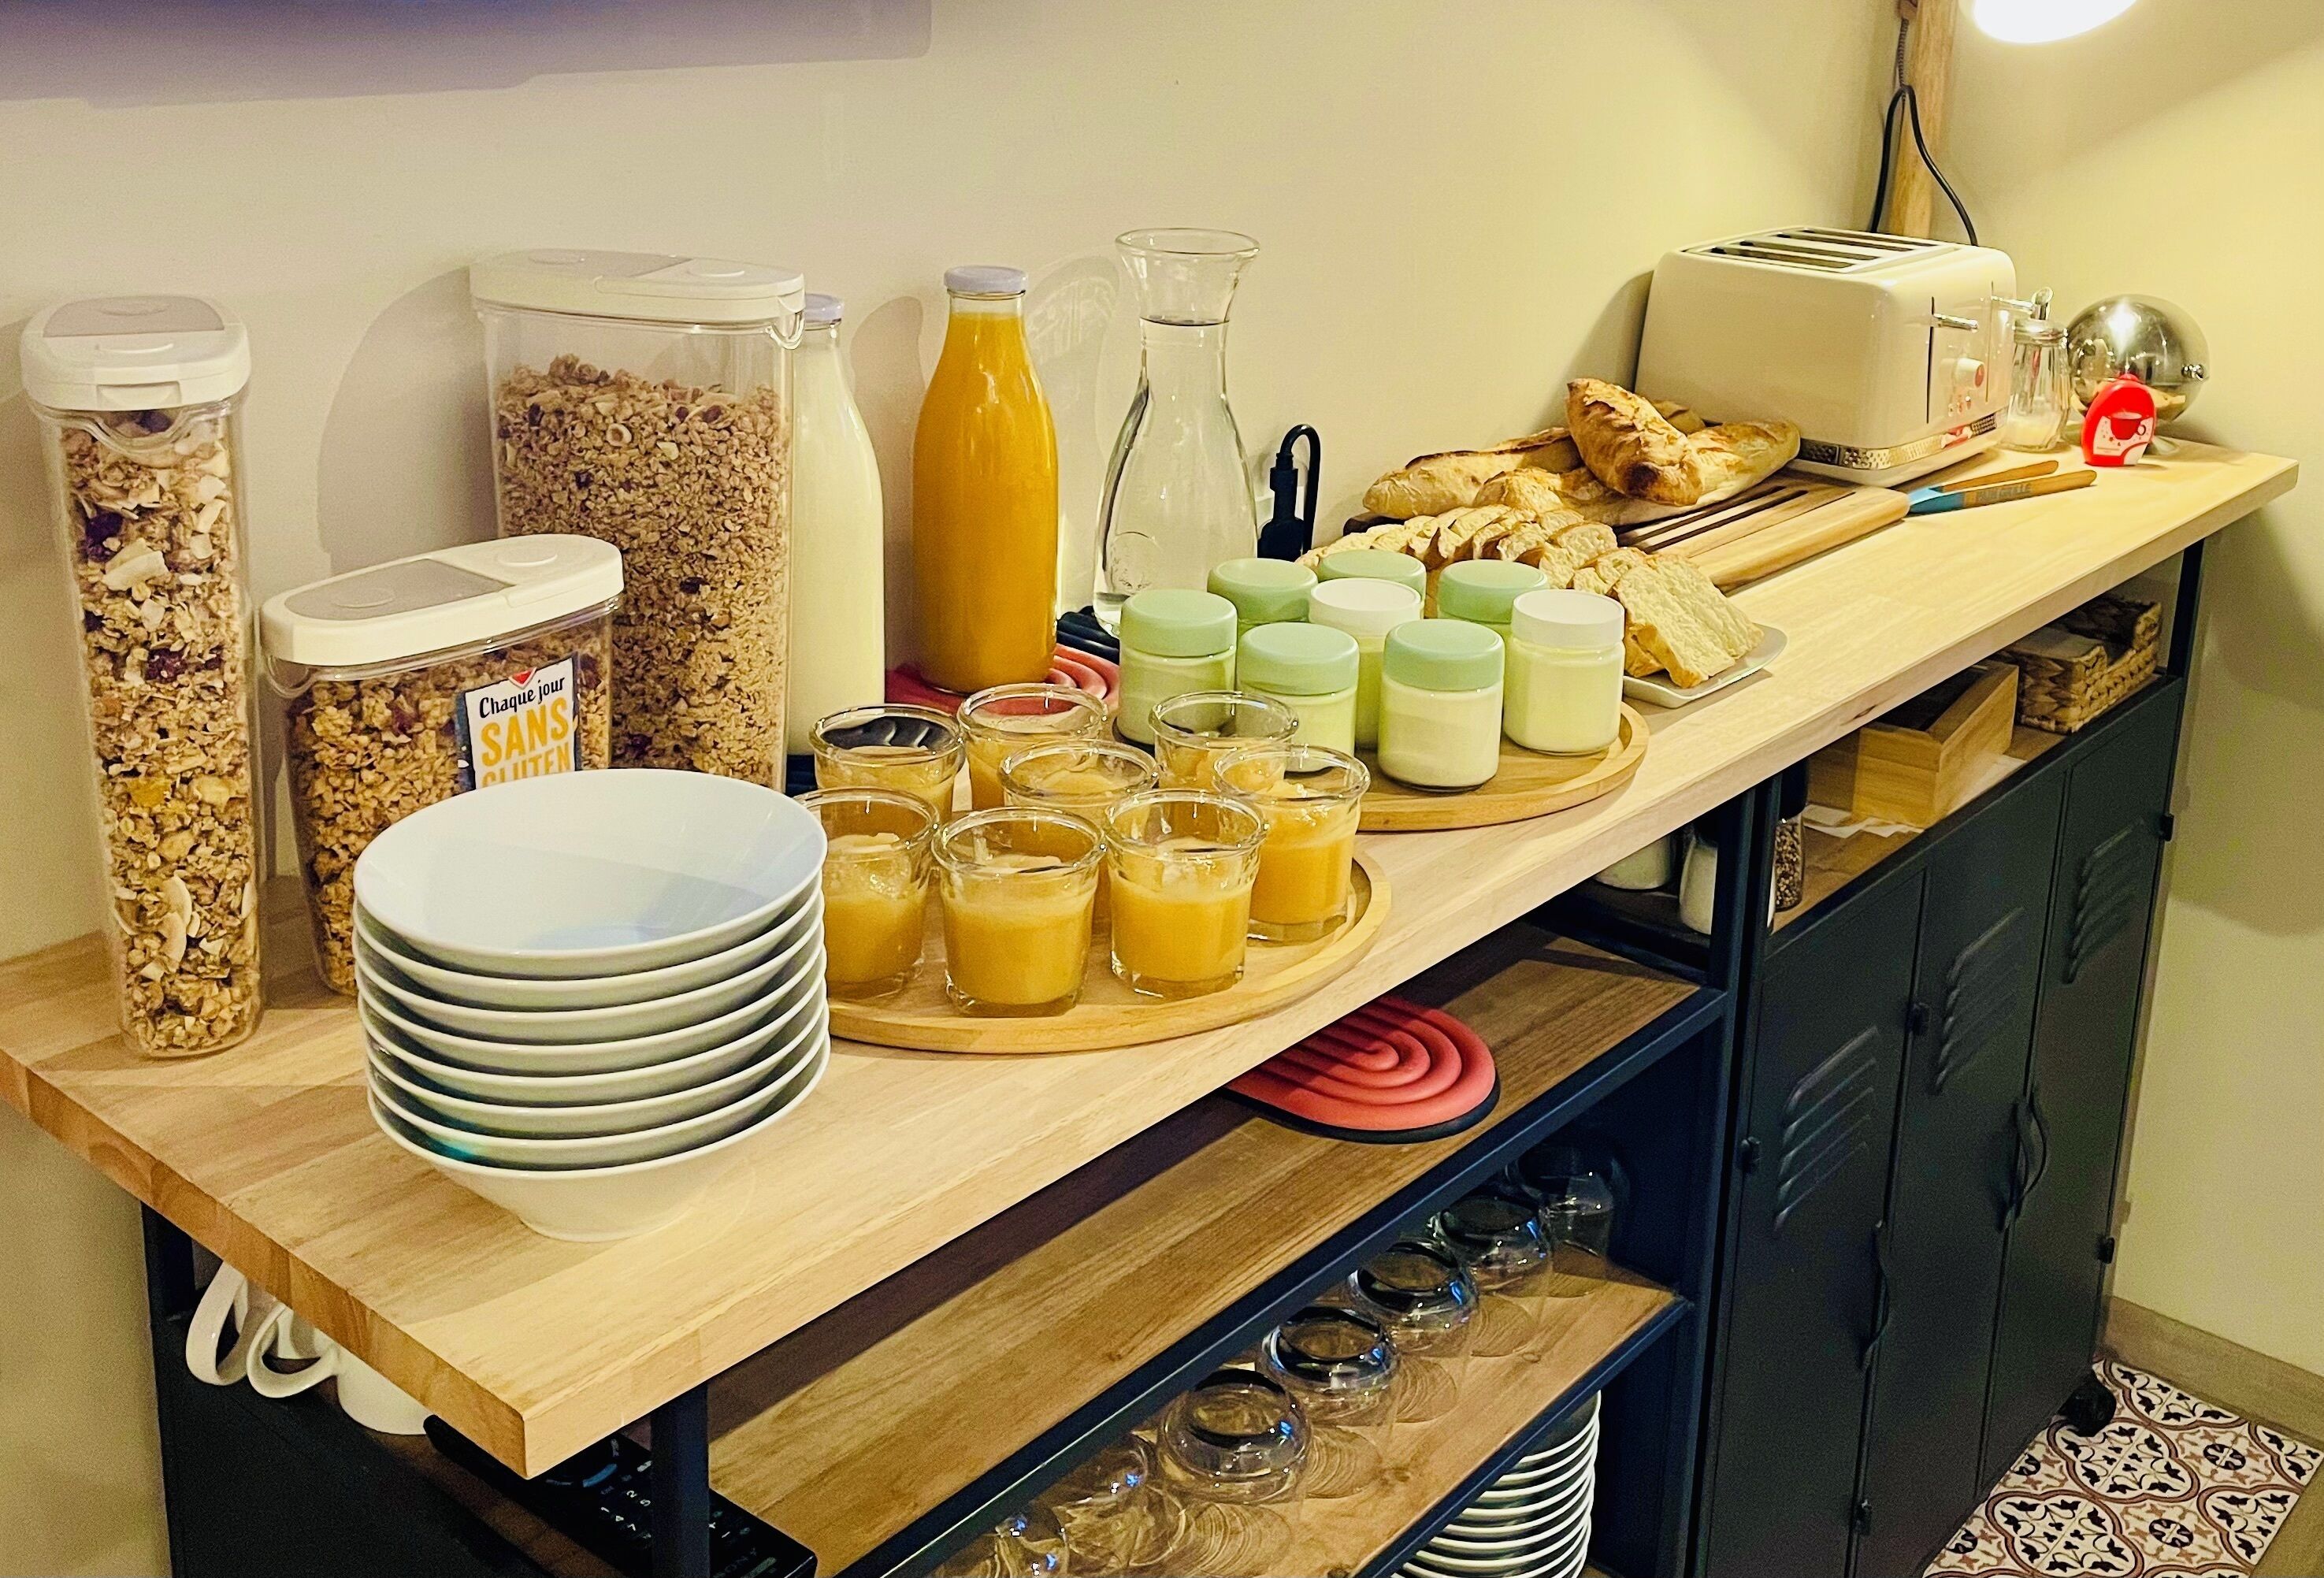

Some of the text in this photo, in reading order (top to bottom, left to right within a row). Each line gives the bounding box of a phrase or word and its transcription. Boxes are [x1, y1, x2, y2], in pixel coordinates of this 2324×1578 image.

[479, 677, 565, 718] Chaque jour
[481, 697, 569, 767] SANS
[626, 1490, 638, 1498] 2
